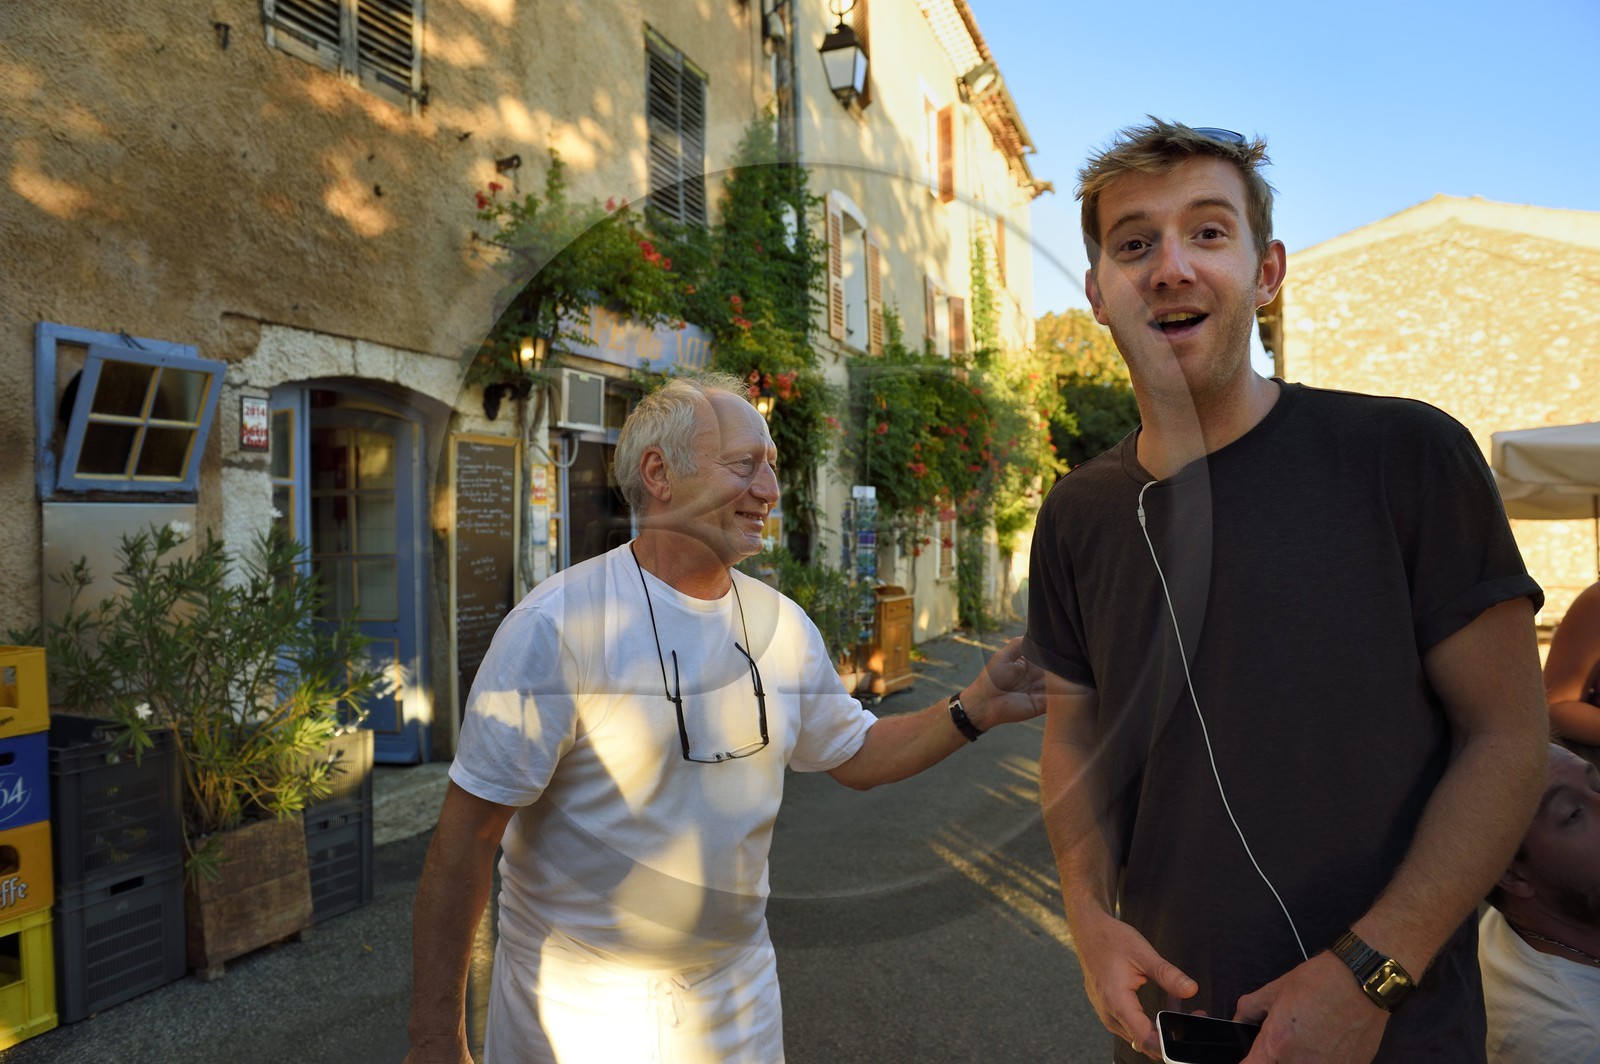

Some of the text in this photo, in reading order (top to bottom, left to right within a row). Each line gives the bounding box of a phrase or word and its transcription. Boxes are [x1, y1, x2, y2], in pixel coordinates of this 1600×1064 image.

[557, 303, 716, 371] AFE du MID
[244, 406, 266, 417] 2014
[0, 877, 28, 909] ffe
